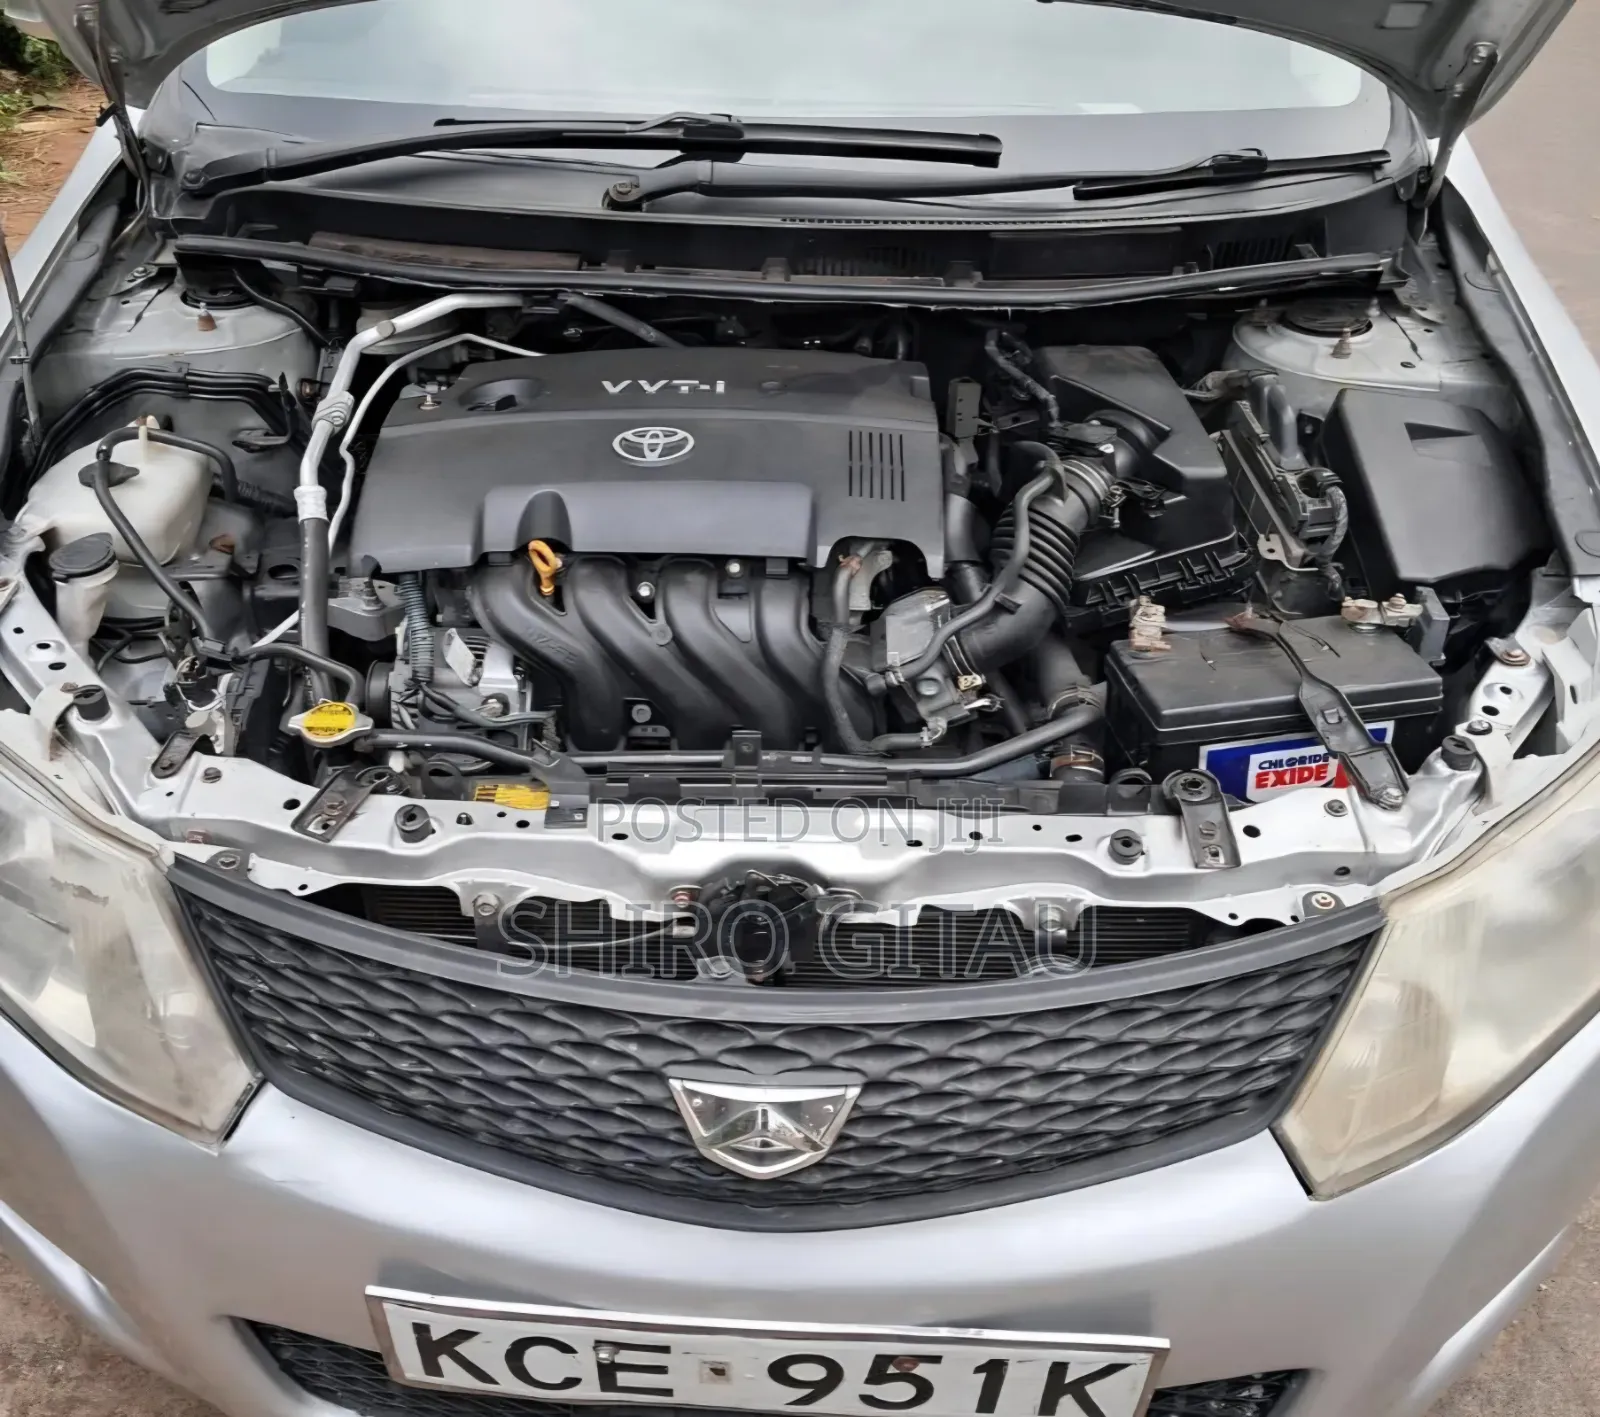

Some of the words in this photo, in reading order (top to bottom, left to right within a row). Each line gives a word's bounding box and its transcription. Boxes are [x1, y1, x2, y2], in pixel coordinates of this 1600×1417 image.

[1258, 752, 1330, 770] CHLORIDE
[1255, 763, 1330, 789] EXIDE
[411, 1321, 675, 1398] KCE
[767, 1352, 1137, 1417] 951K
